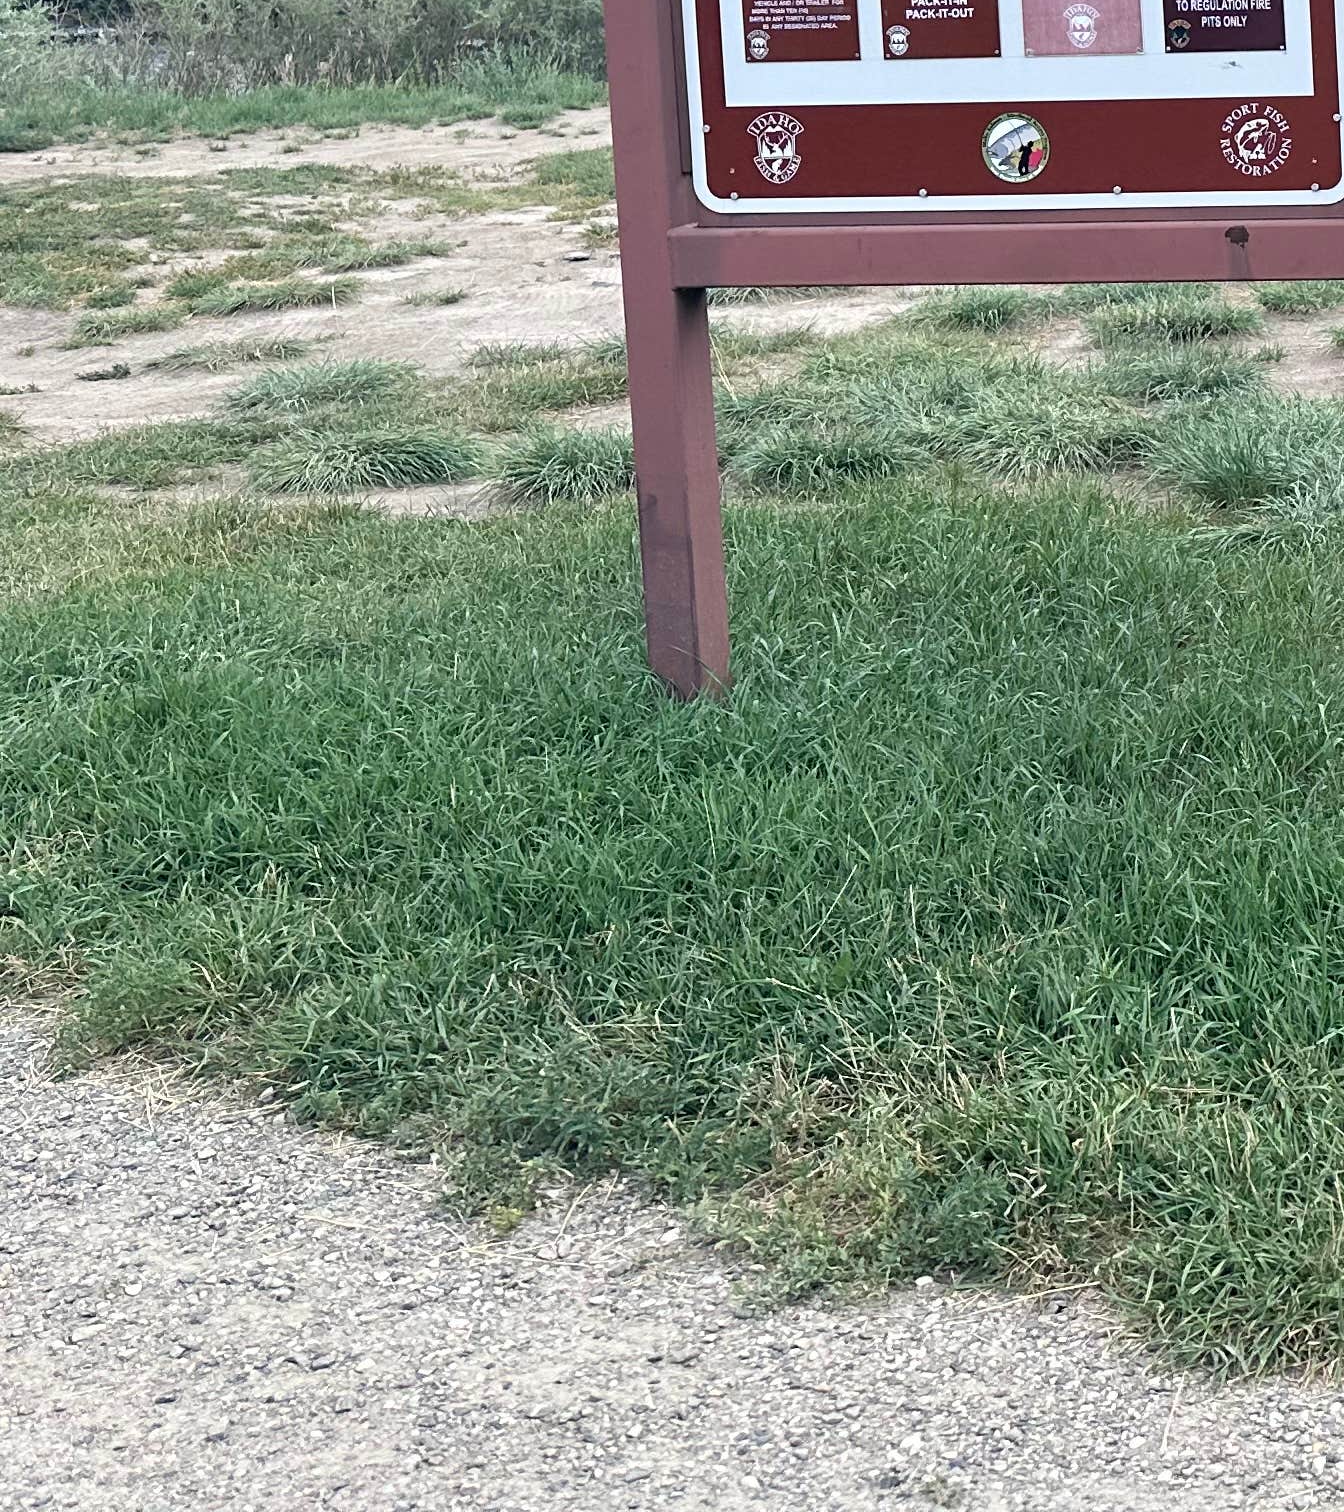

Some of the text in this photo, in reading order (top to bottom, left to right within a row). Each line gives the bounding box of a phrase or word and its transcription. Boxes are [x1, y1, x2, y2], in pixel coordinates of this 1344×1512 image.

[906, 8, 974, 19] PACK-IT-OUT
[1176, 0, 1271, 11] TO REGULATION FIRE
[1202, 16, 1247, 27] PITS ONLY
[749, 114, 801, 136] IDAHO
[1222, 103, 1290, 133] SPORT FISH
[1220, 137, 1292, 177] RESTORATION
